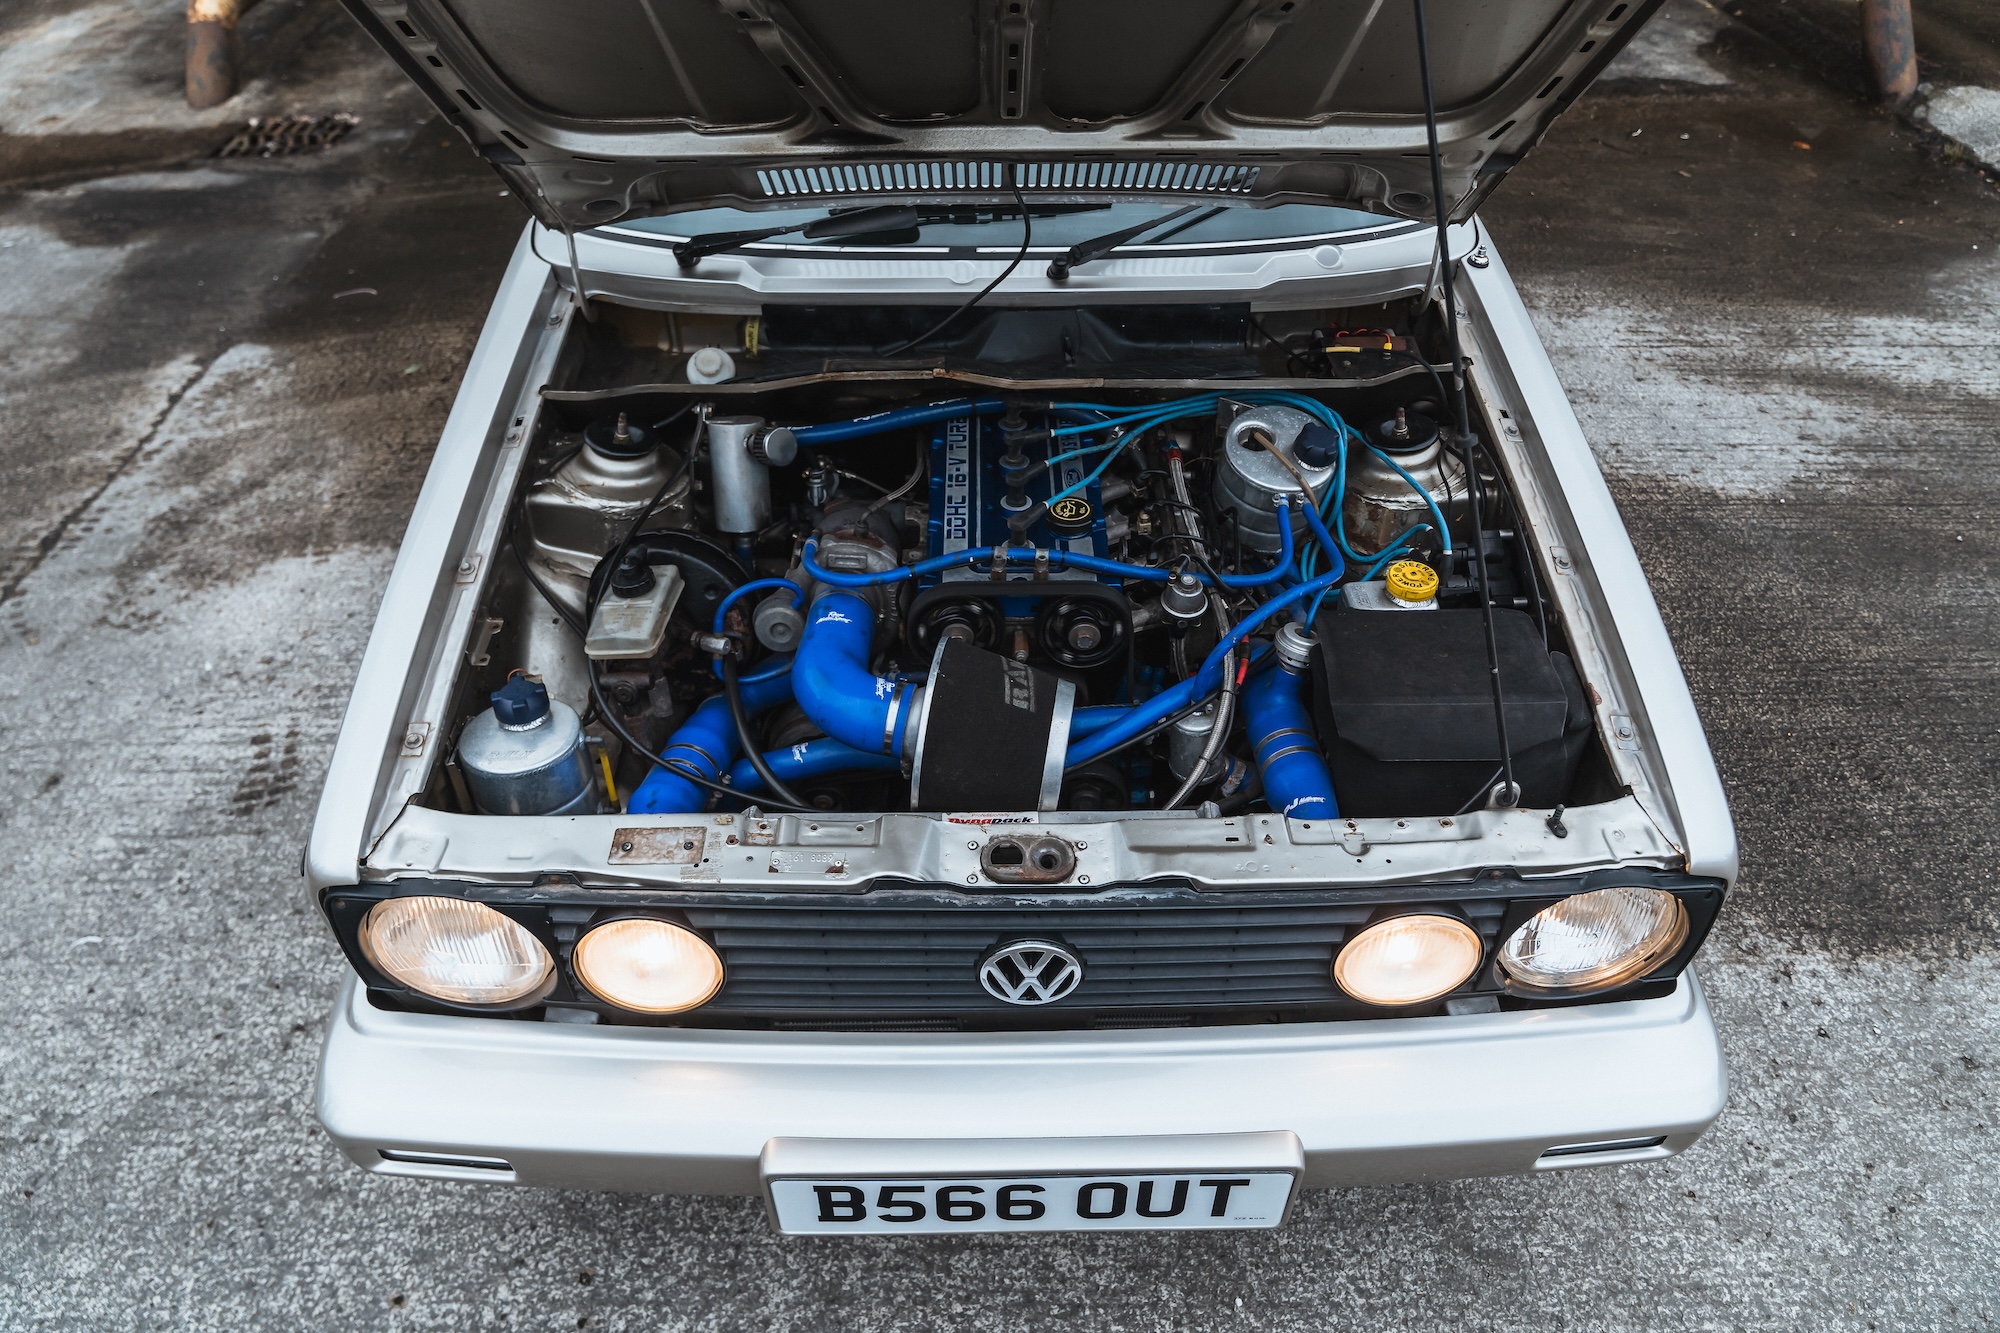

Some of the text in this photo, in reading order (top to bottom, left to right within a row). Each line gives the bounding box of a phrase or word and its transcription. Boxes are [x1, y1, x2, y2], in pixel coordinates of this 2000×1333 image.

[946, 493, 967, 540] DOHC
[812, 1178, 1251, 1223] B566 OUT
